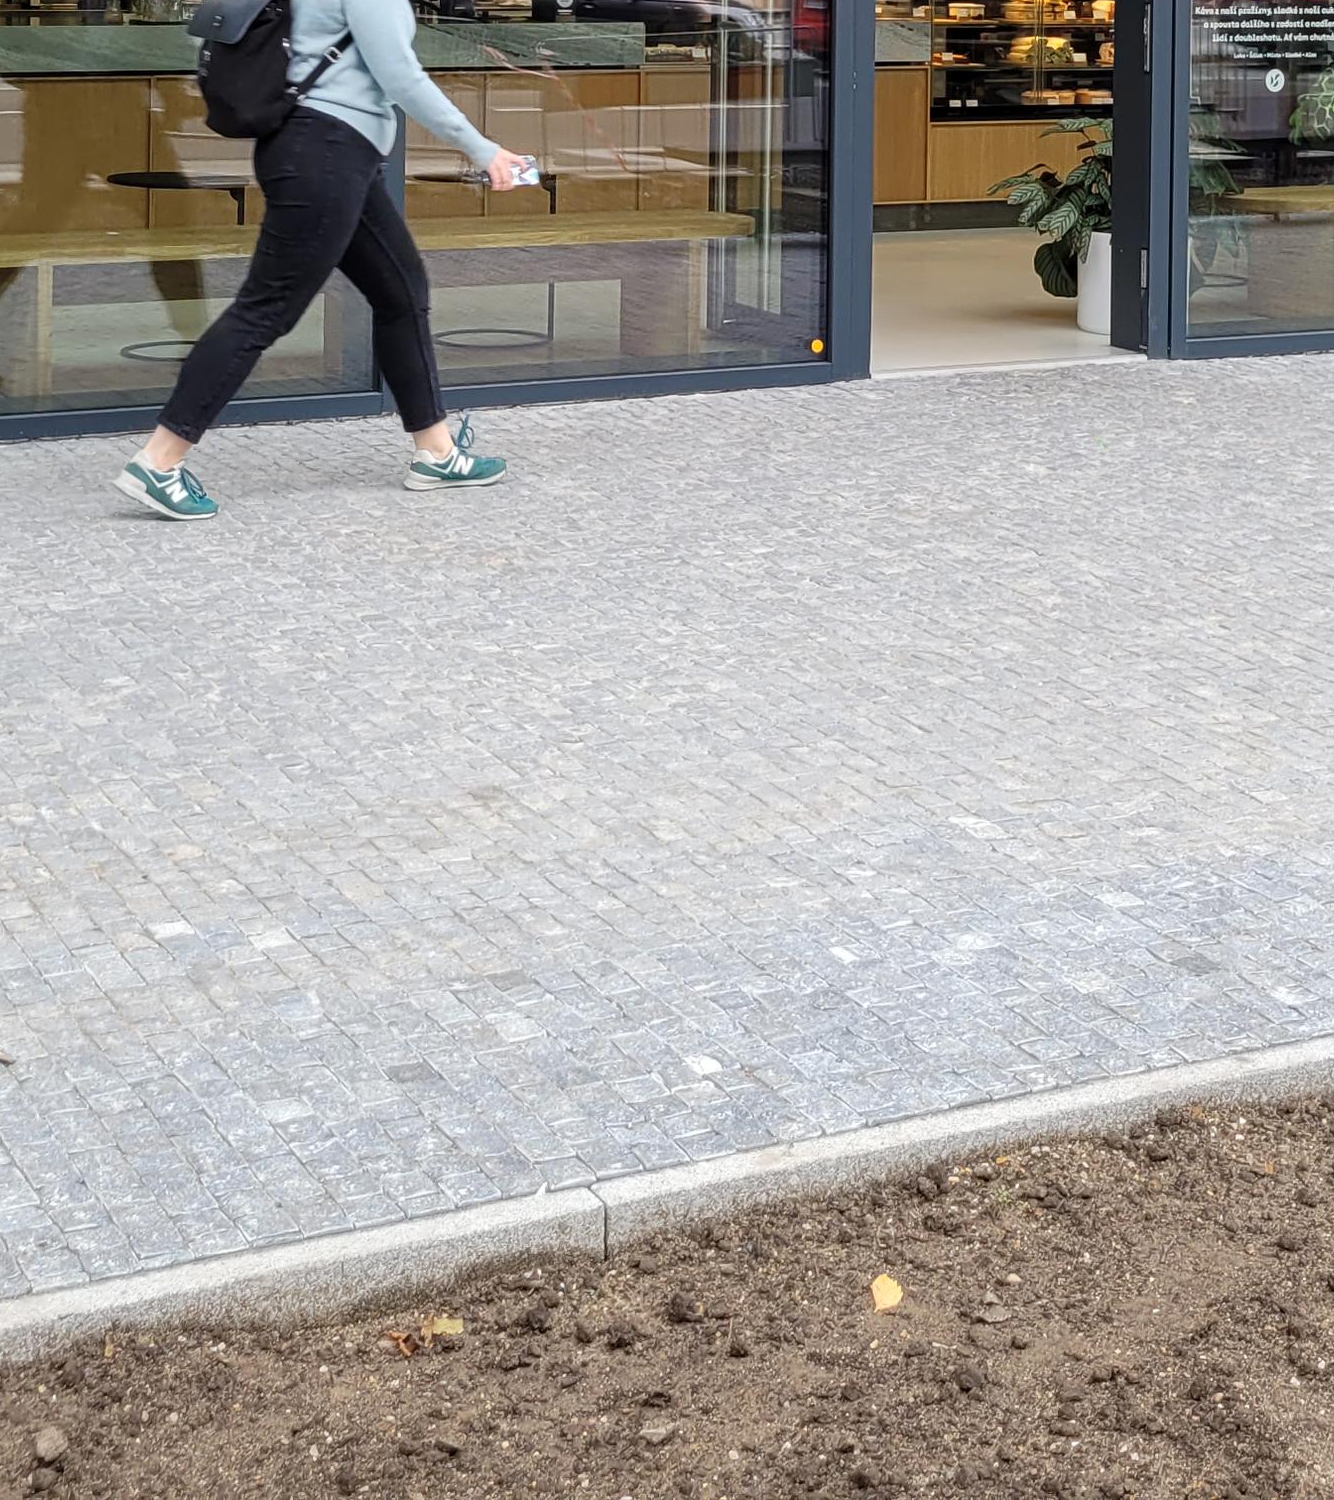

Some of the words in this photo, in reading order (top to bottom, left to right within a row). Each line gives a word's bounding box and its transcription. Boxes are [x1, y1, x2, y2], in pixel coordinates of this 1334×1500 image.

[1195, 6, 1214, 15] Káva
[1210, 21, 1239, 30] spousta
[452, 455, 474, 476] N
[165, 481, 189, 503] N
